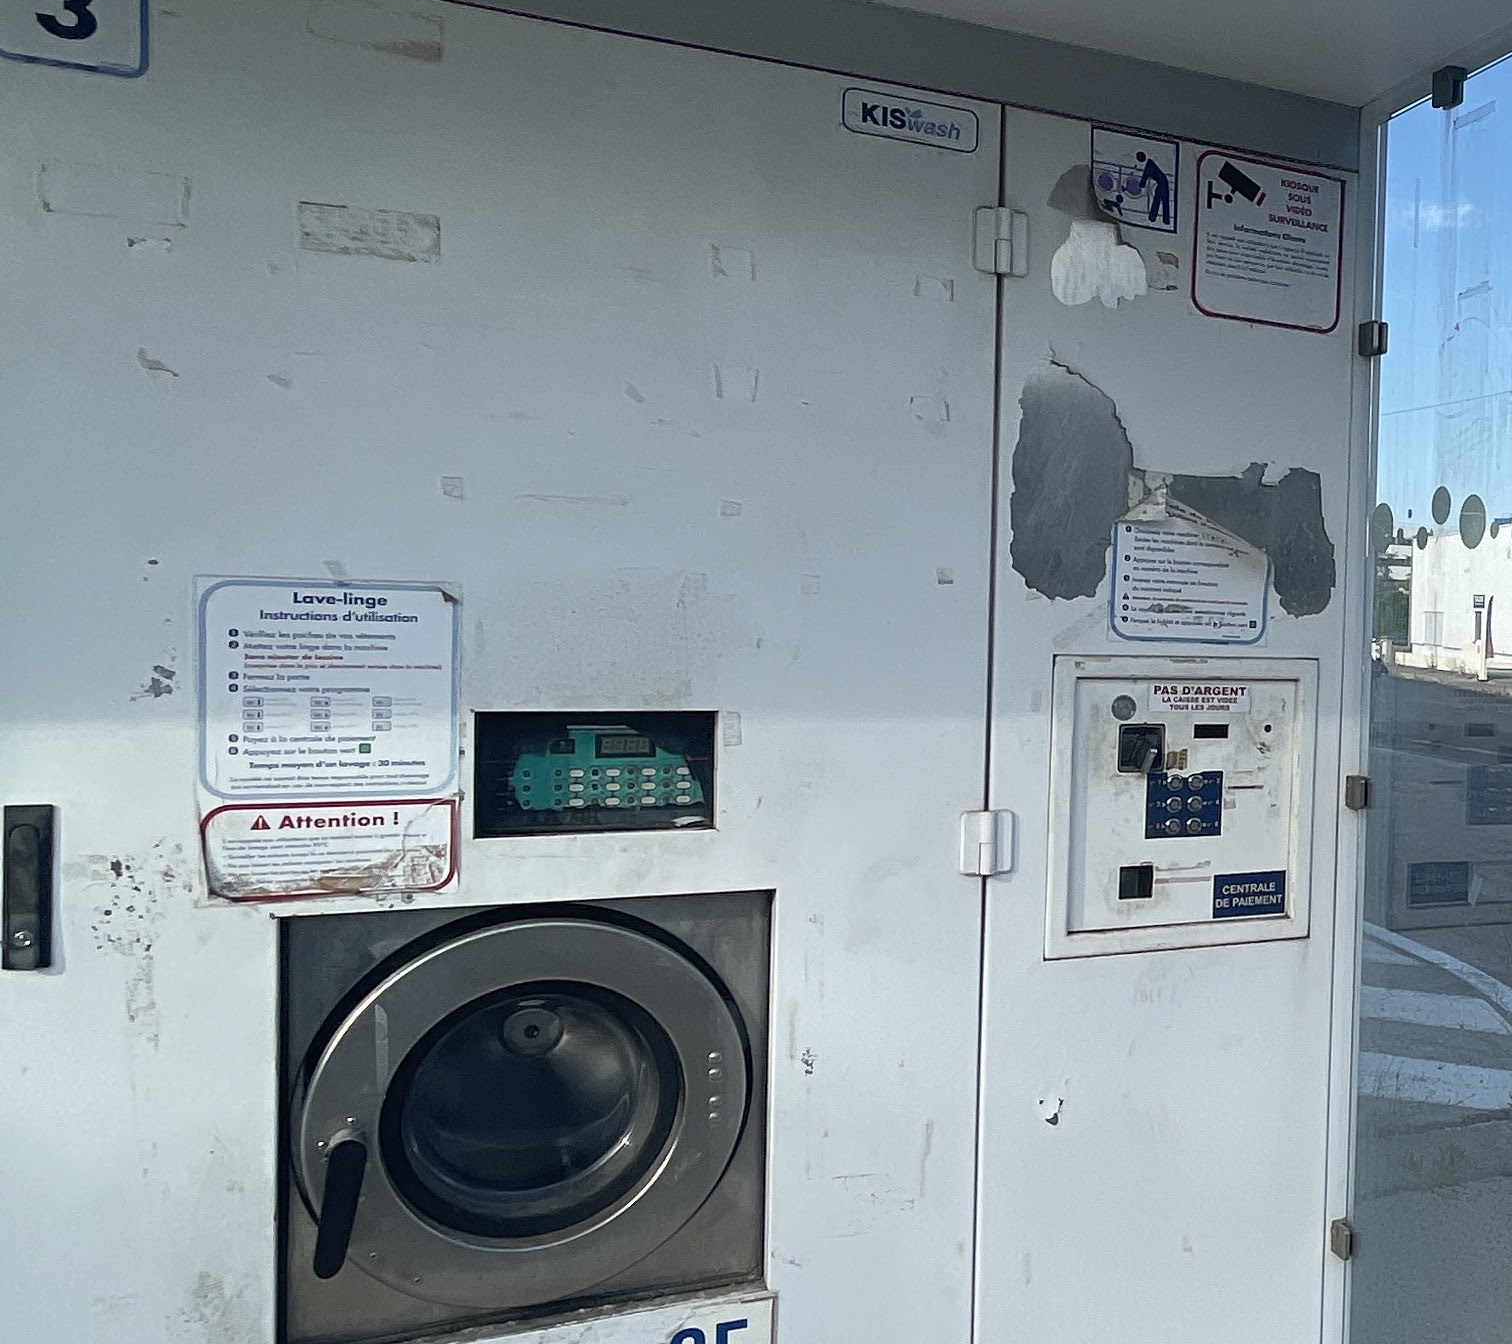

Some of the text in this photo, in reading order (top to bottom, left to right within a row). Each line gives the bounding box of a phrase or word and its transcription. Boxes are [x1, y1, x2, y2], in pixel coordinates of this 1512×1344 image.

[292, 591, 388, 609] Lave-linge
[259, 609, 338, 622] Instructions
[1153, 685, 1247, 696] PAS D'ARGENT
[277, 812, 385, 830] Attention
[1221, 881, 1276, 895] CENTRALE
[1215, 894, 1283, 909] DE PAIEMENT
